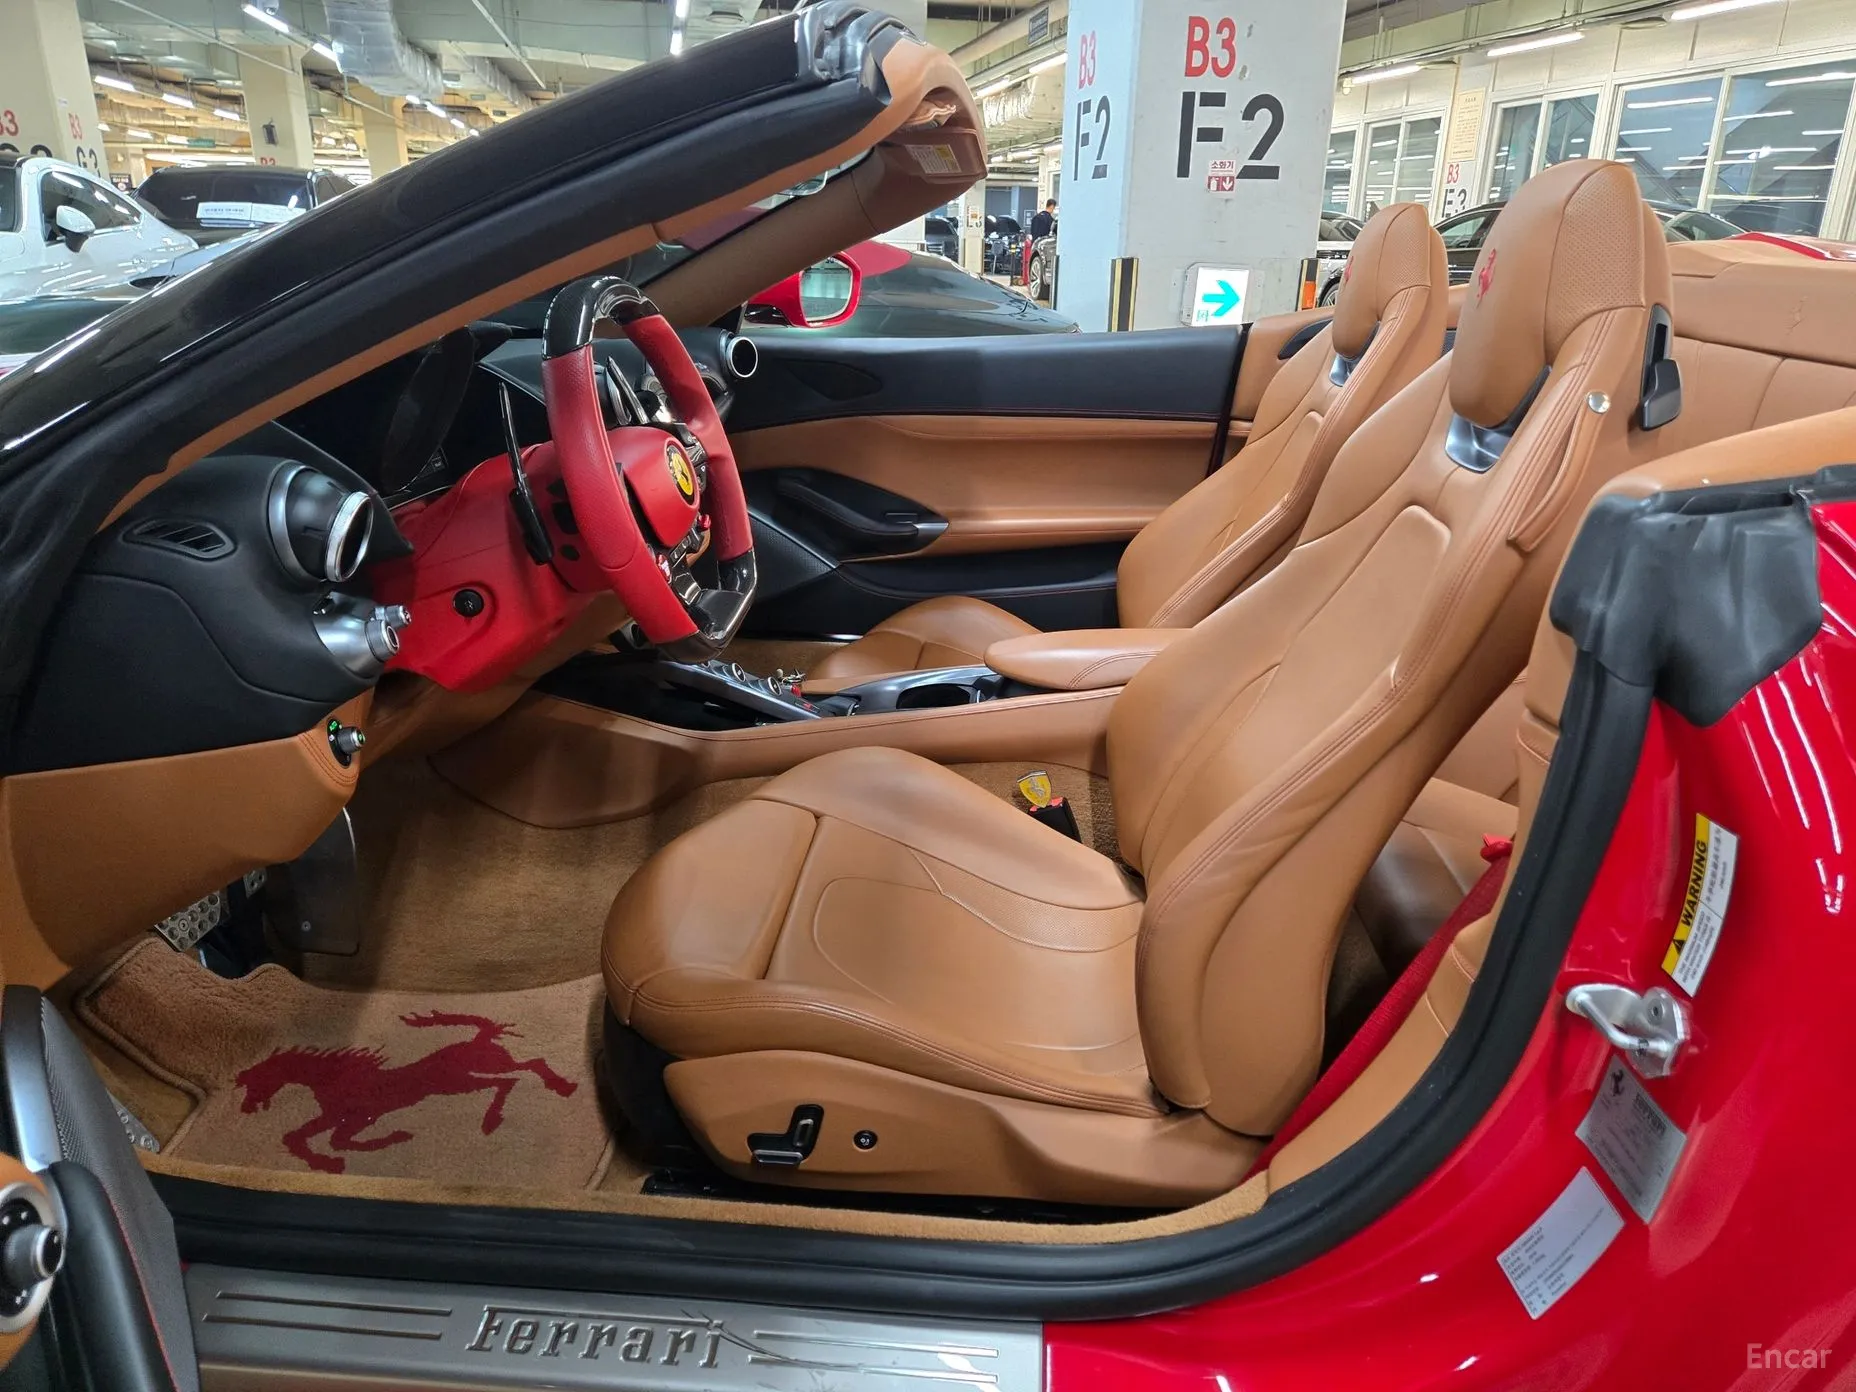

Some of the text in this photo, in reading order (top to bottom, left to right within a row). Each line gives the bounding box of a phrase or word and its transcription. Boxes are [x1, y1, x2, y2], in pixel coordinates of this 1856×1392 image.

[1079, 30, 1097, 90] B3
[1185, 15, 1237, 78] B3
[68, 112, 83, 140] B3
[1073, 95, 1111, 182] F2
[1177, 91, 1285, 180] F2
[1211, 160, 1234, 170] 소화기
[1447, 163, 1460, 185] B3
[1681, 841, 1707, 927] WARNING
[465, 1304, 724, 1368] Ferrari
